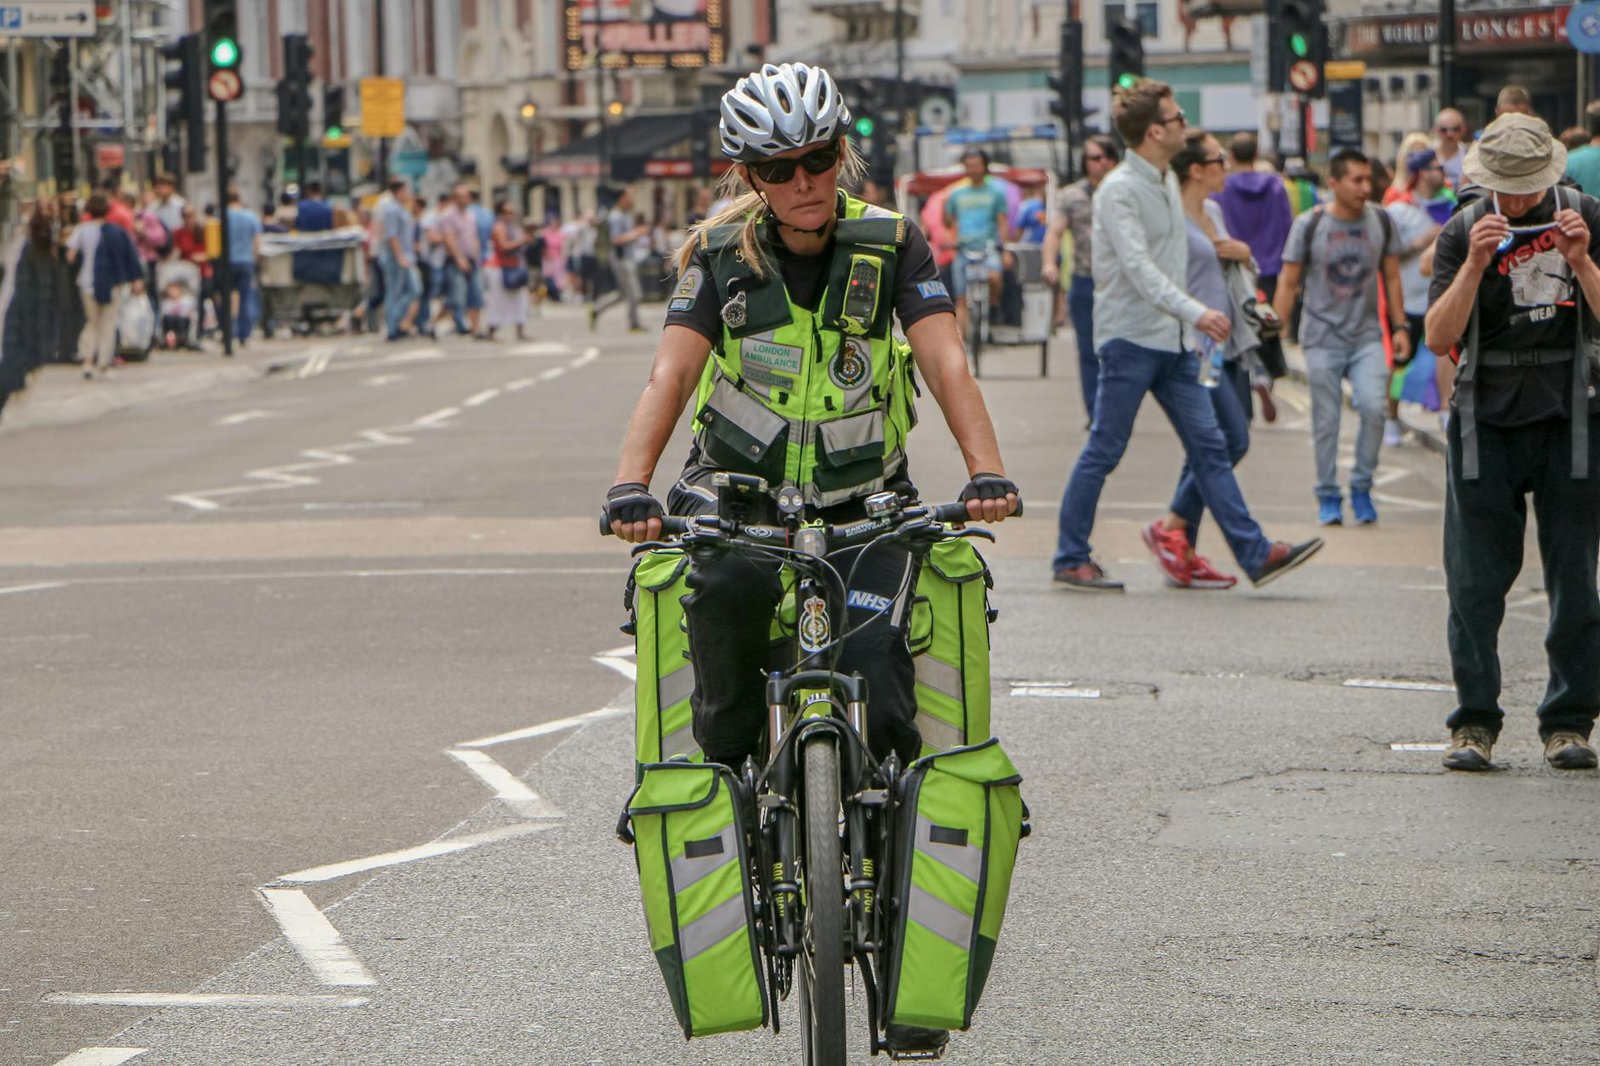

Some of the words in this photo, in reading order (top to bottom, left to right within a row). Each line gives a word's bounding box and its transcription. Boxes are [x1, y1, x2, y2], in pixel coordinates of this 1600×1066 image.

[1498, 229, 1555, 276] VISIO
[753, 344, 790, 357] LONDON
[745, 352, 798, 369] AMBULANCE
[850, 590, 891, 610] NHS
